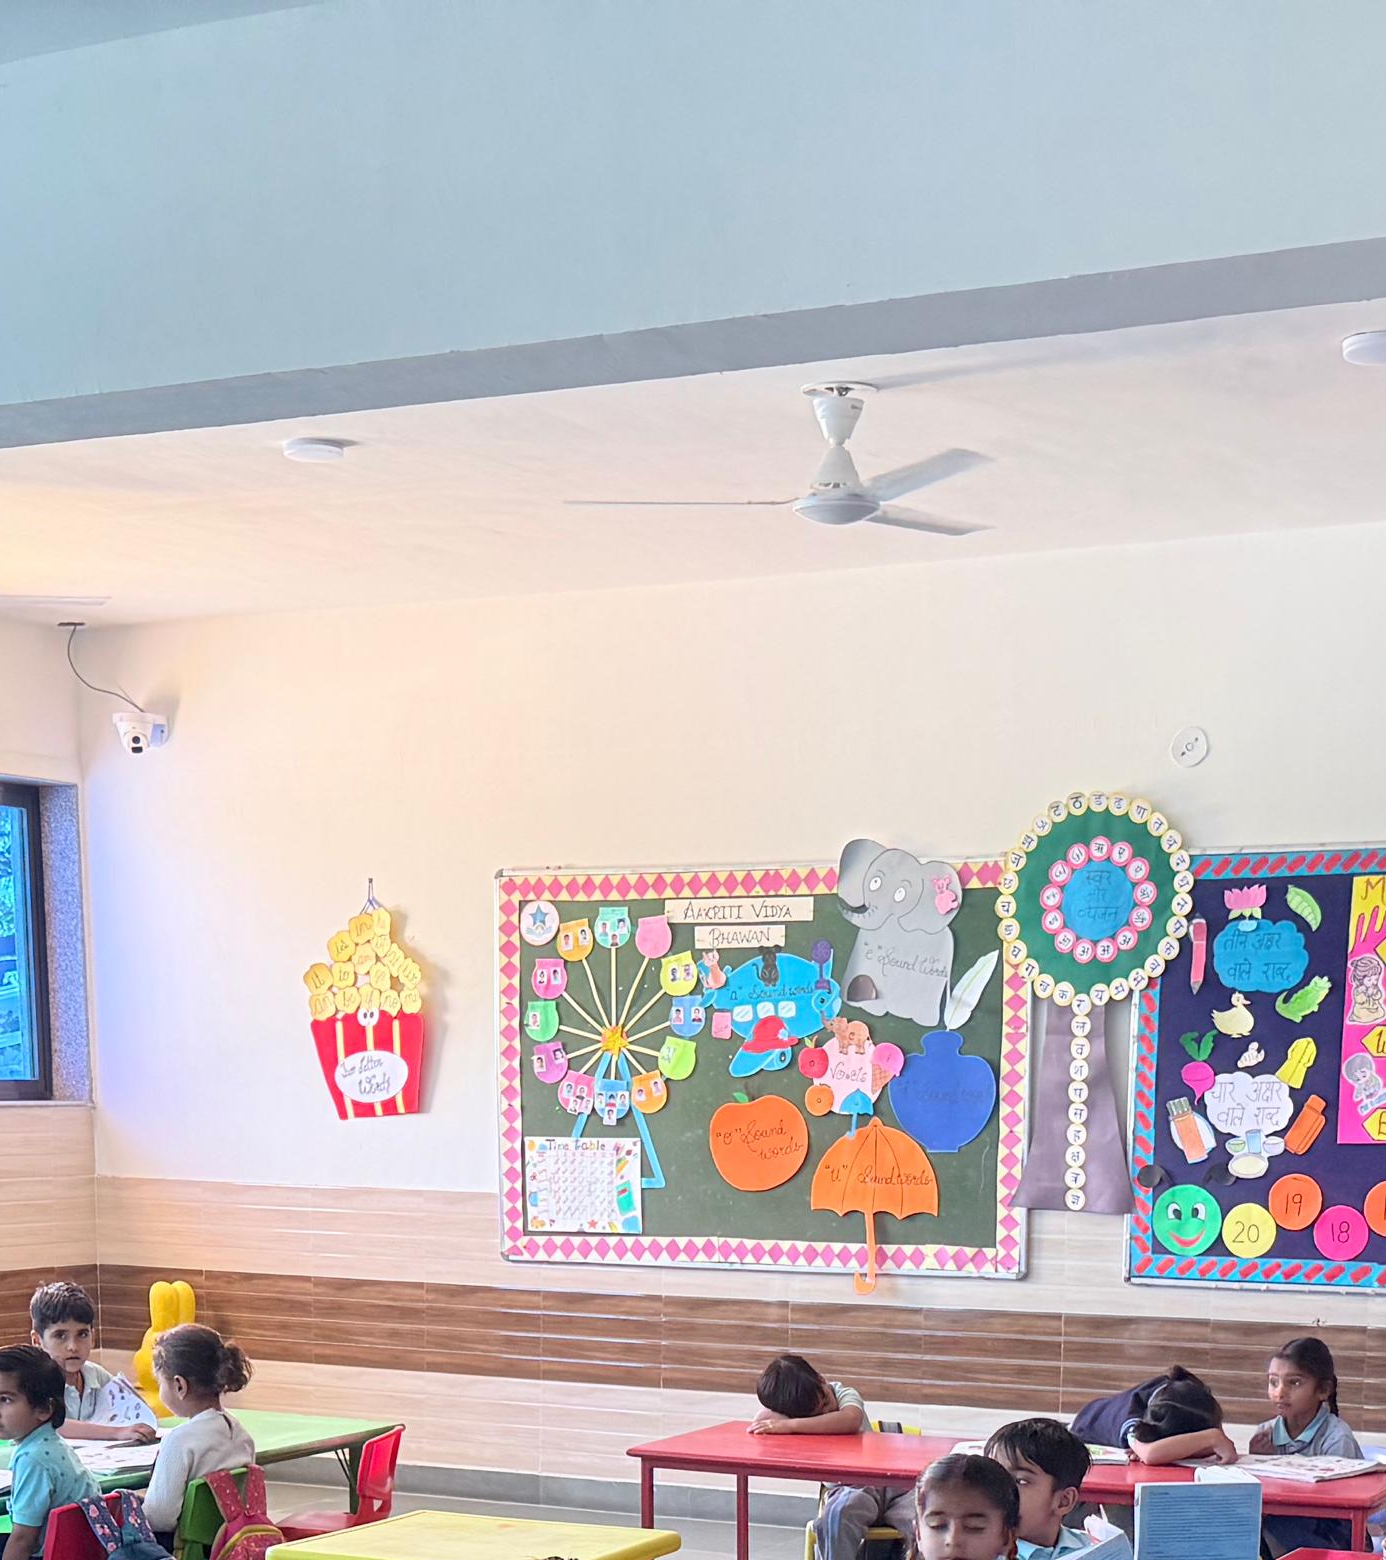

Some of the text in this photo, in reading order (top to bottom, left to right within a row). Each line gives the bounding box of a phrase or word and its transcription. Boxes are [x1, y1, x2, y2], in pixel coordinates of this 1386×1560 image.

[684, 900, 792, 920] AAKRITI VIDYA
[709, 927, 770, 946] BHAWAN
[1224, 930, 1247, 950] तीन
[1227, 958, 1253, 982] वाले
[1246, 1081, 1283, 1101] अक्षर
[1217, 1103, 1245, 1127] वाले
[1285, 1193, 1303, 1217] 19
[1232, 1220, 1261, 1244] 20
[1331, 1222, 1350, 1245] 18
